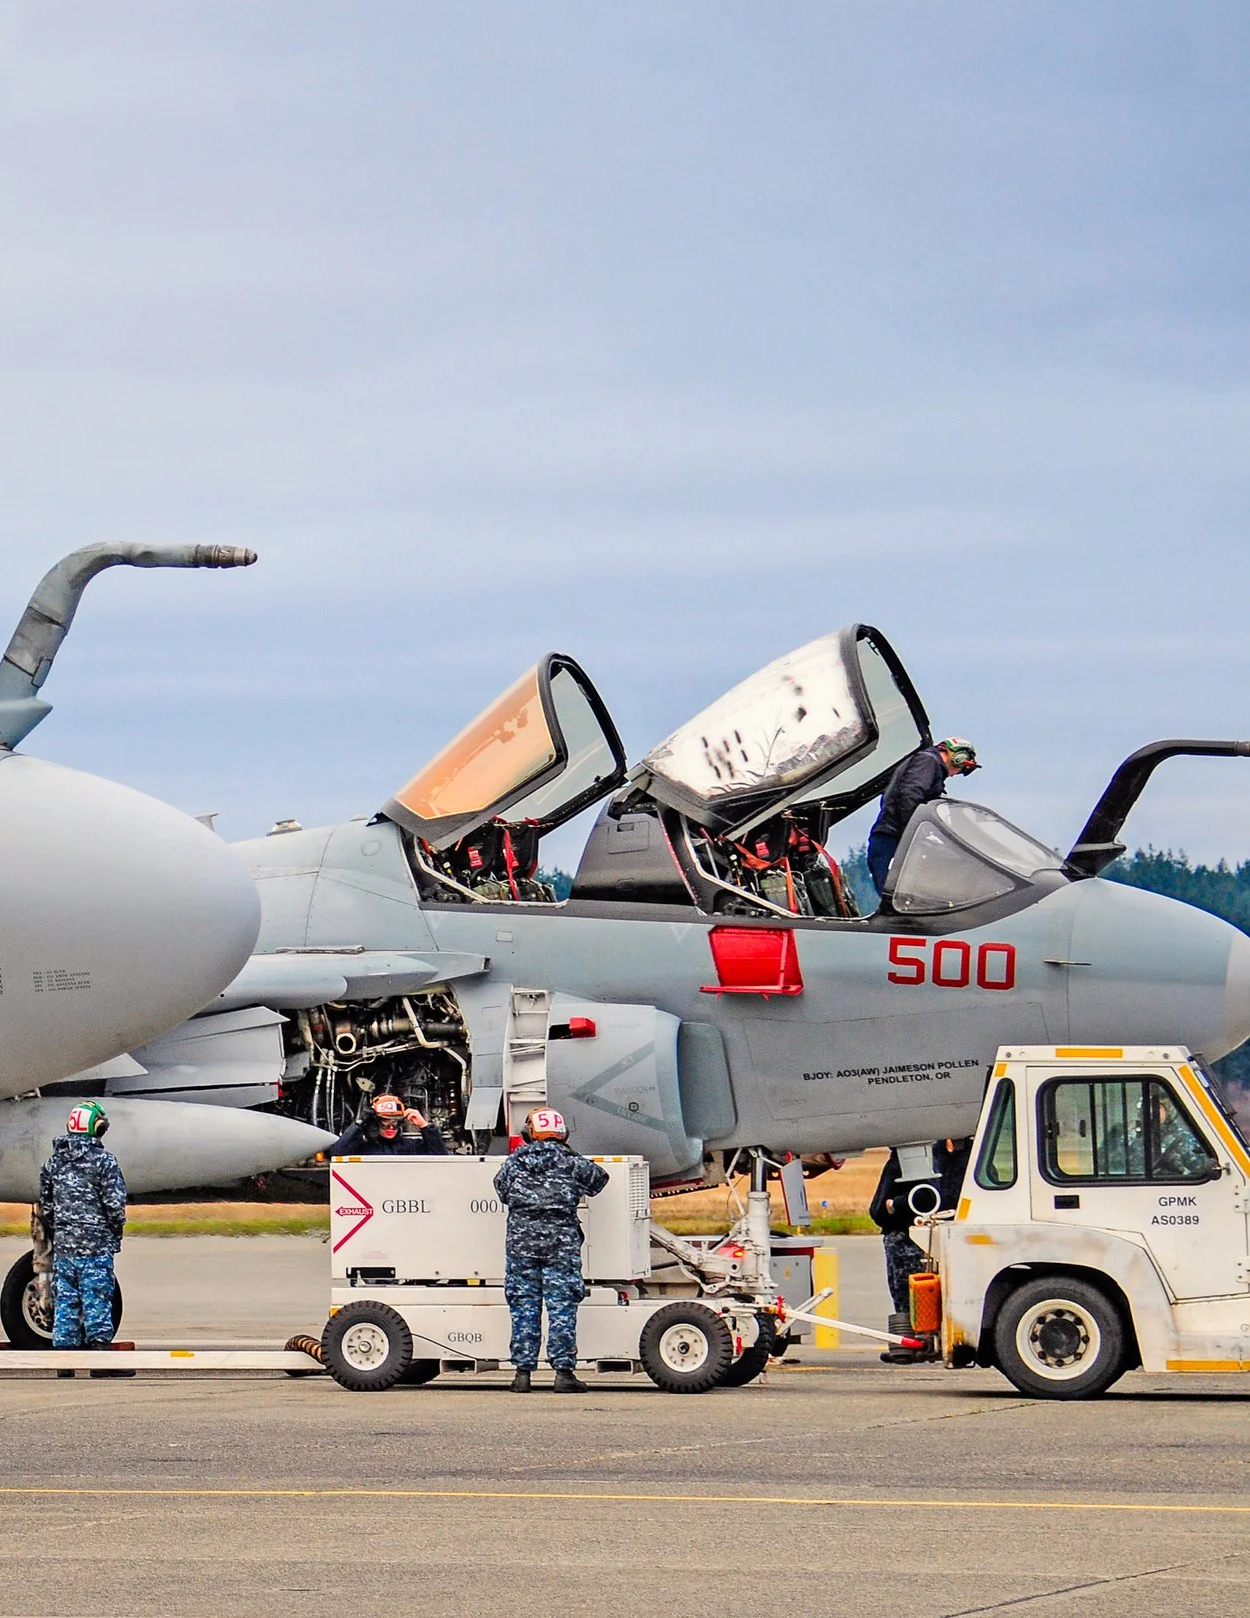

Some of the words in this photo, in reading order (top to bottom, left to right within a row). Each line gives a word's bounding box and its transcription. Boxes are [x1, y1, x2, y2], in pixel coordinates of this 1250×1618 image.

[887, 936, 1016, 990] 500
[803, 1071, 834, 1081] BJOY:
[882, 1063, 935, 1075] JAIMESON
[937, 1059, 979, 1071] POLLEN
[867, 1074, 934, 1086] PENDLETON,
[935, 1071, 951, 1081] OR
[69, 1110, 88, 1131] 5L
[382, 1199, 431, 1214] GBBL
[1158, 1196, 1197, 1206] GPMK
[340, 1207, 374, 1216] EXHAUST
[1151, 1215, 1200, 1225] AS0389
[447, 1332, 482, 1344] GBQB
